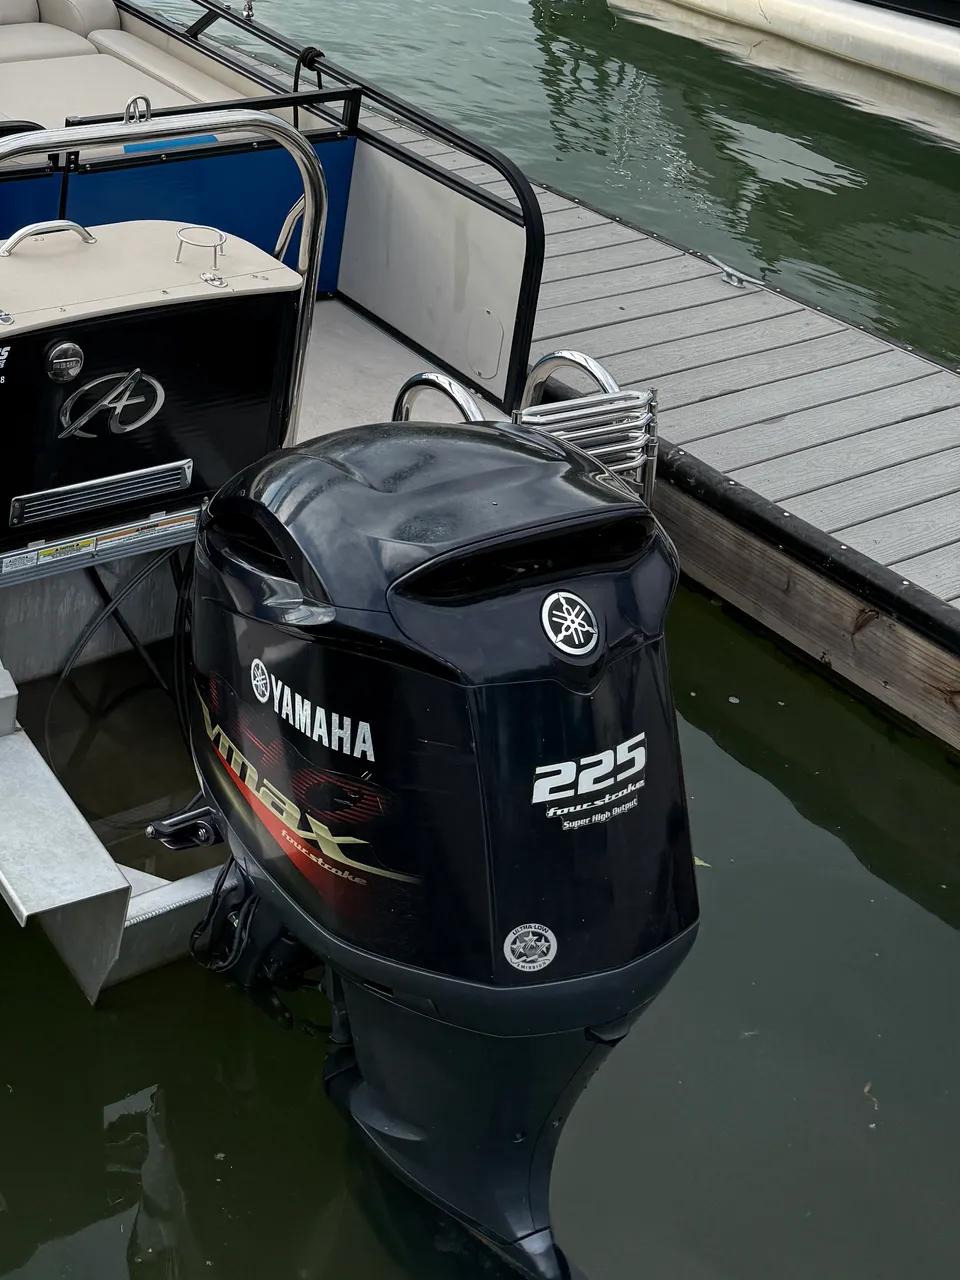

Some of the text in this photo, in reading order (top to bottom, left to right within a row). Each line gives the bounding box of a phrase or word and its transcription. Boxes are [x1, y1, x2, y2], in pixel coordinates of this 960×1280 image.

[271, 674, 376, 762] YAMAHA
[532, 731, 646, 804] 225
[563, 797, 638, 830] Super High Output
